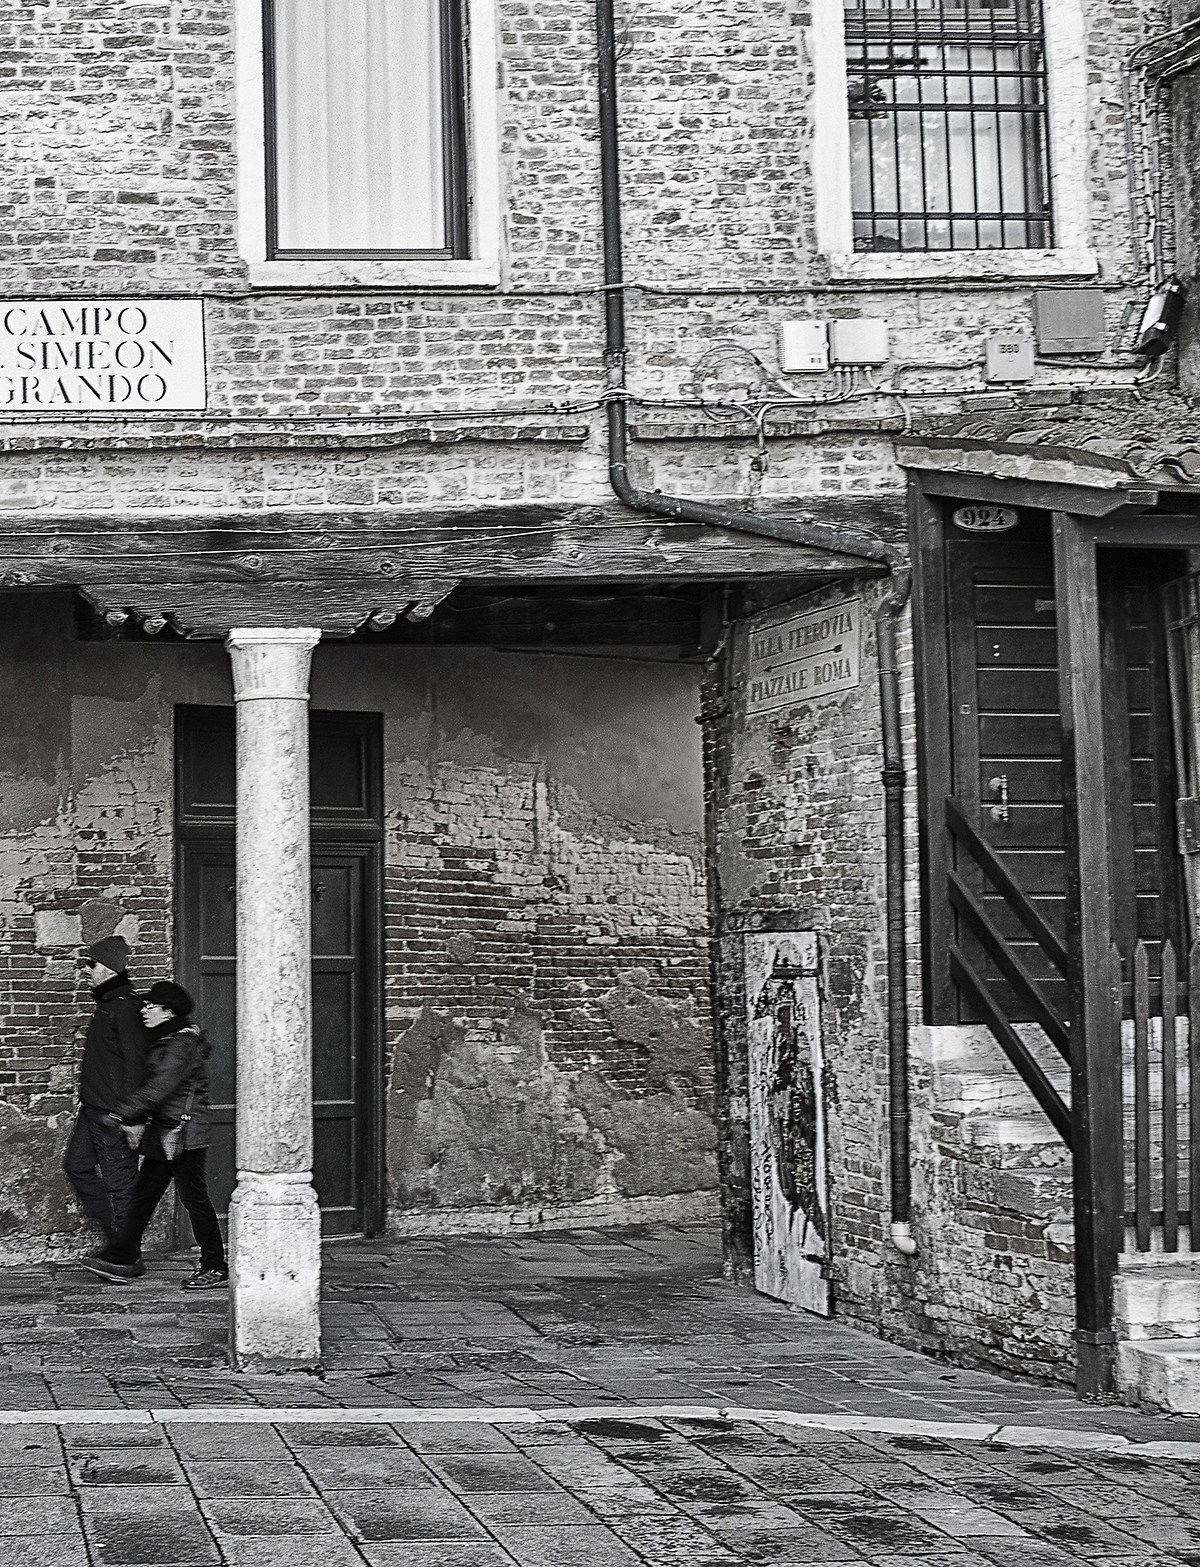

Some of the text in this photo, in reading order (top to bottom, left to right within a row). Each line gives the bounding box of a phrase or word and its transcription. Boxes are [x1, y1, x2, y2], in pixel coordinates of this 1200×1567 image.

[3, 307, 148, 336] CAMPO
[17, 340, 174, 370] SIMEON
[963, 509, 1006, 526] 924
[751, 612, 853, 661] ALLA FERROVIA
[751, 659, 851, 701] PIAZZALE ROMA
